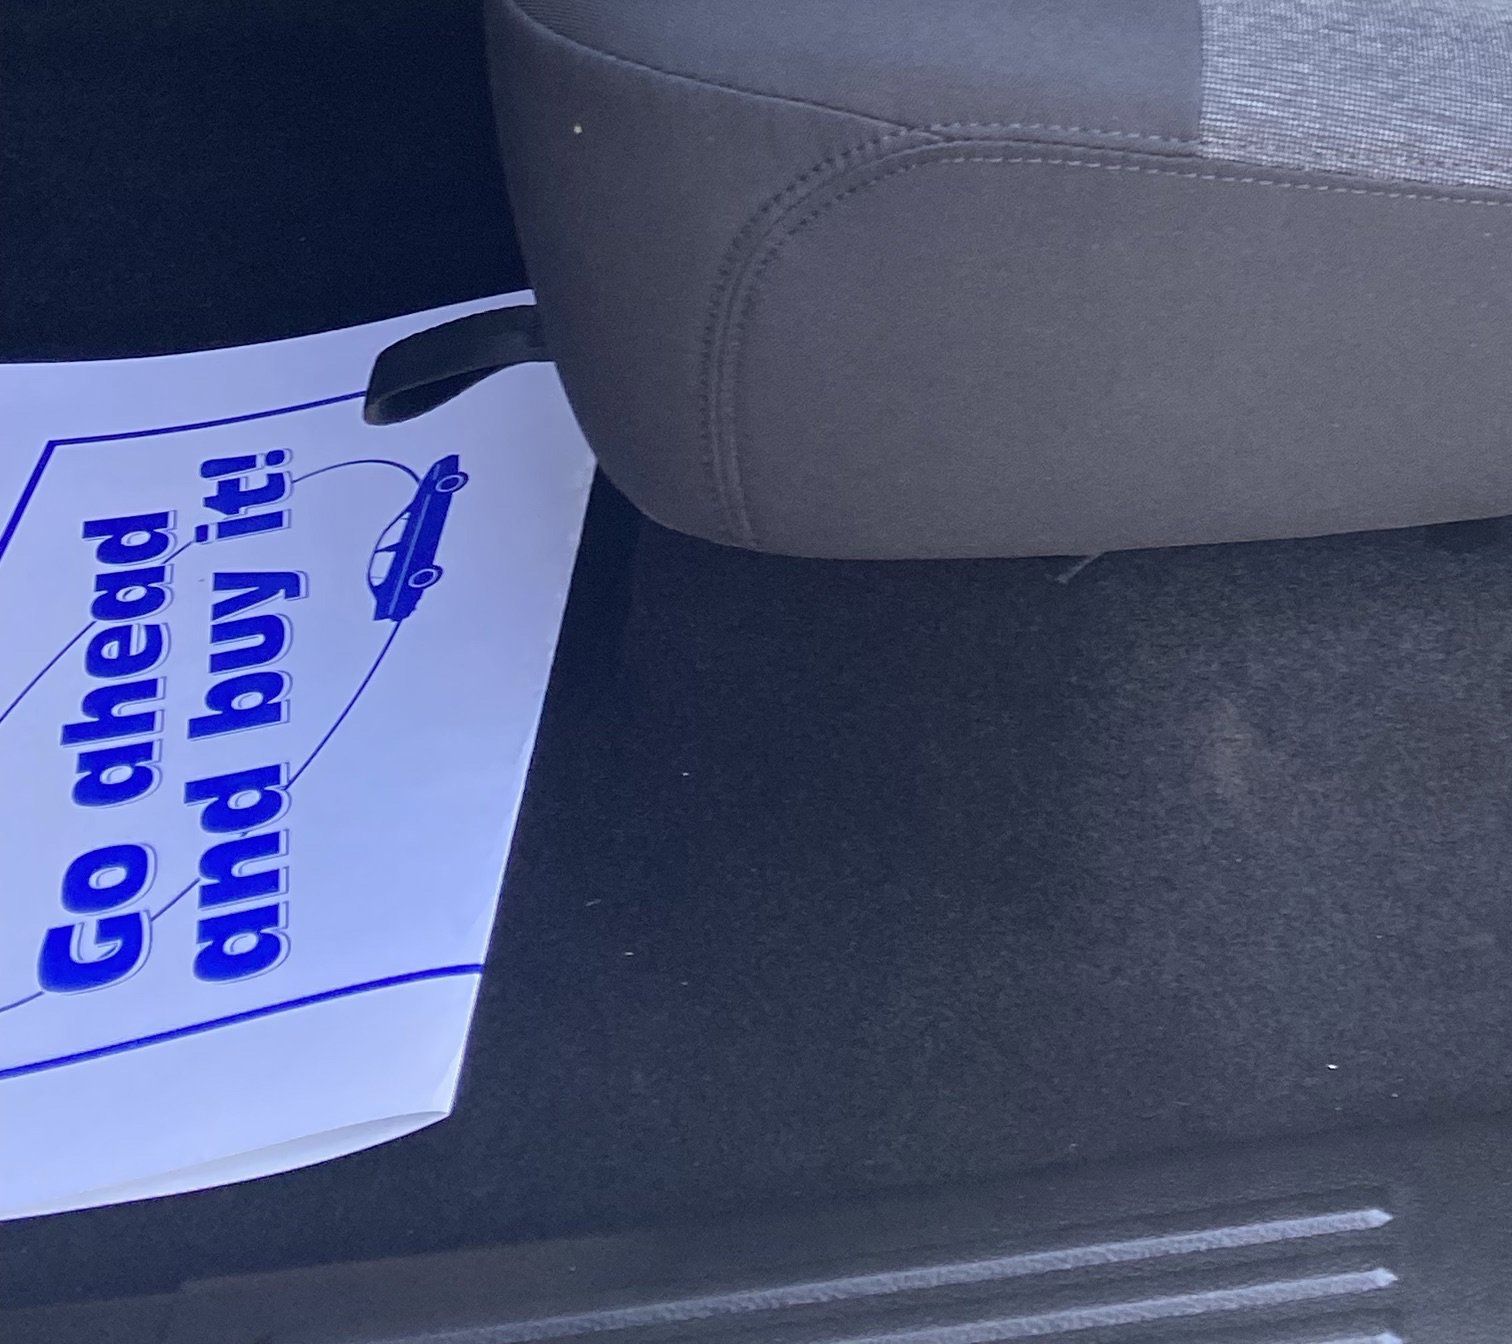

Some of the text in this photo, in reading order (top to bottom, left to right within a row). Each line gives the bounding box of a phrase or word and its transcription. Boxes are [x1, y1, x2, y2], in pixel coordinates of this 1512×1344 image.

[36, 510, 179, 995] Go ahead
[183, 448, 307, 984] and buy it!
